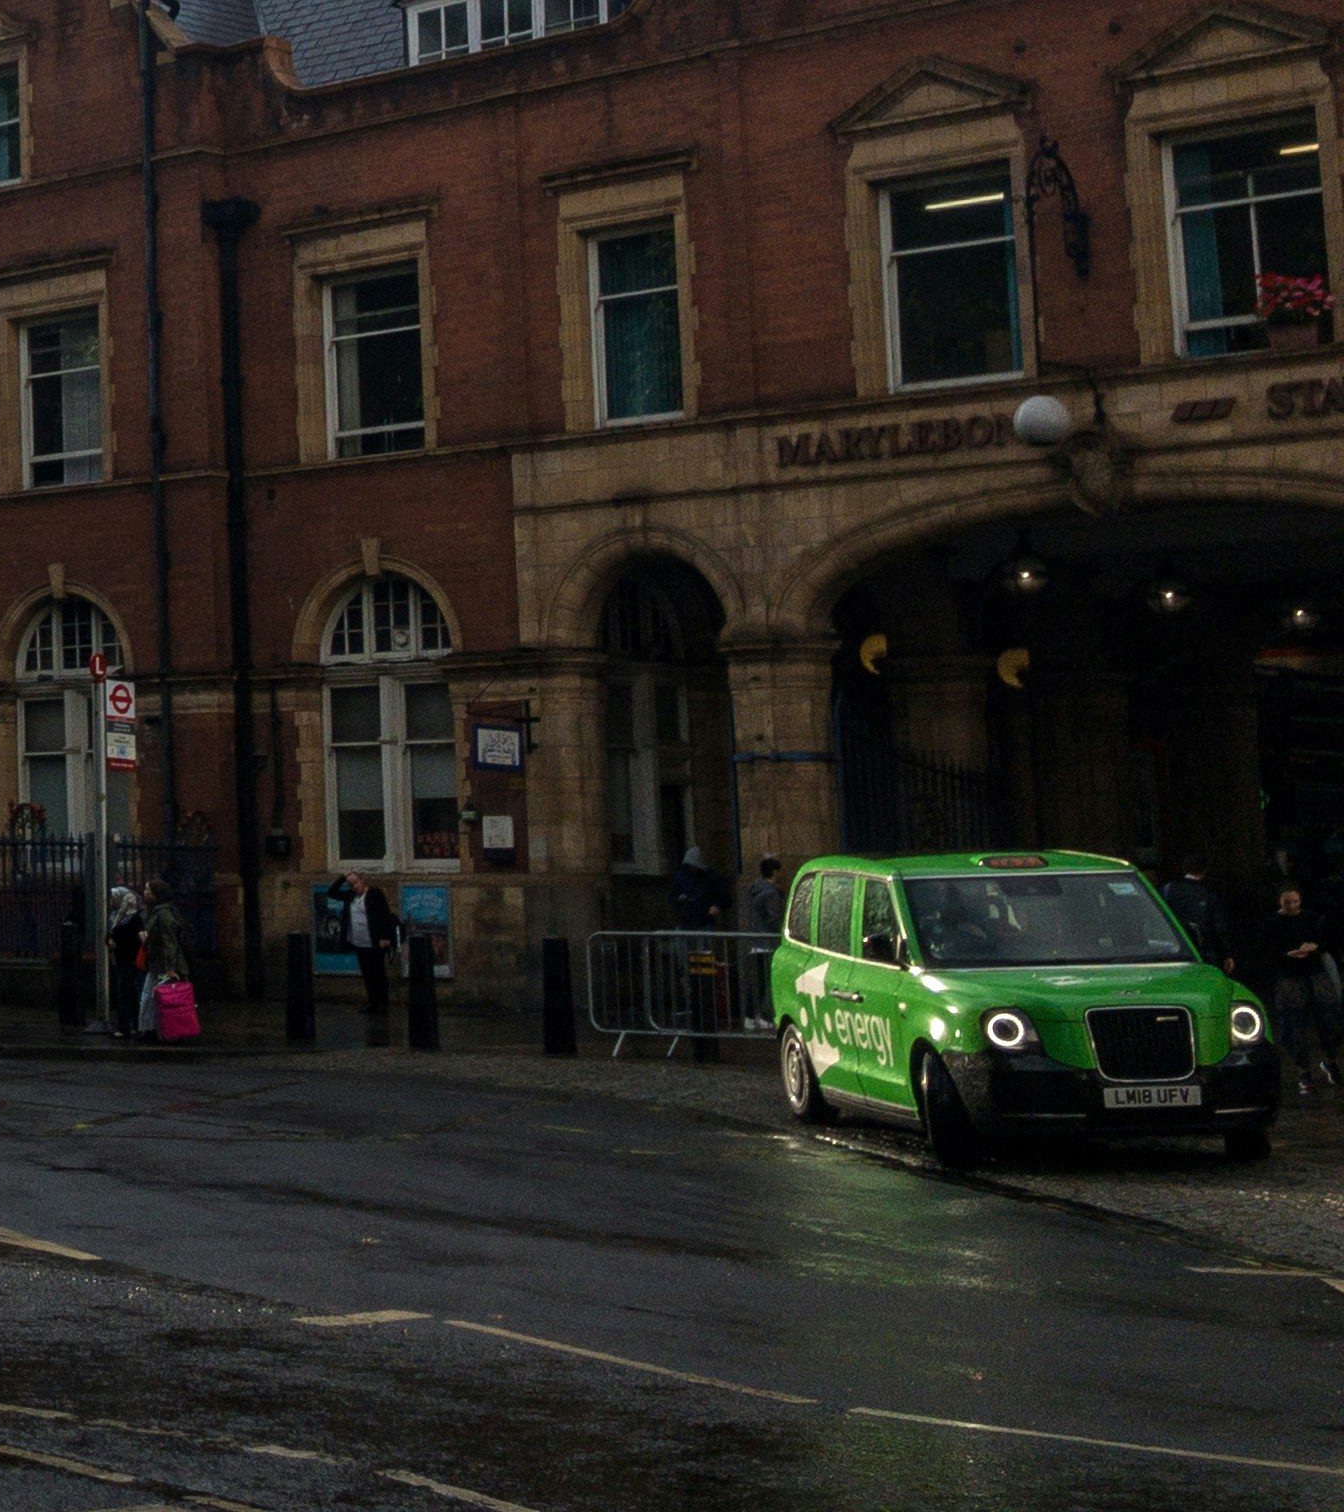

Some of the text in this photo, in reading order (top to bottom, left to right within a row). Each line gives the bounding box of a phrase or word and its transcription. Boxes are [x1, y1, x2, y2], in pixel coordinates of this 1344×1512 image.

[1266, 378, 1344, 420] STA
[777, 414, 1015, 467] MARYLEBON
[835, 1009, 894, 1067] energy
[1115, 1088, 1189, 1104] LM18 UFV
